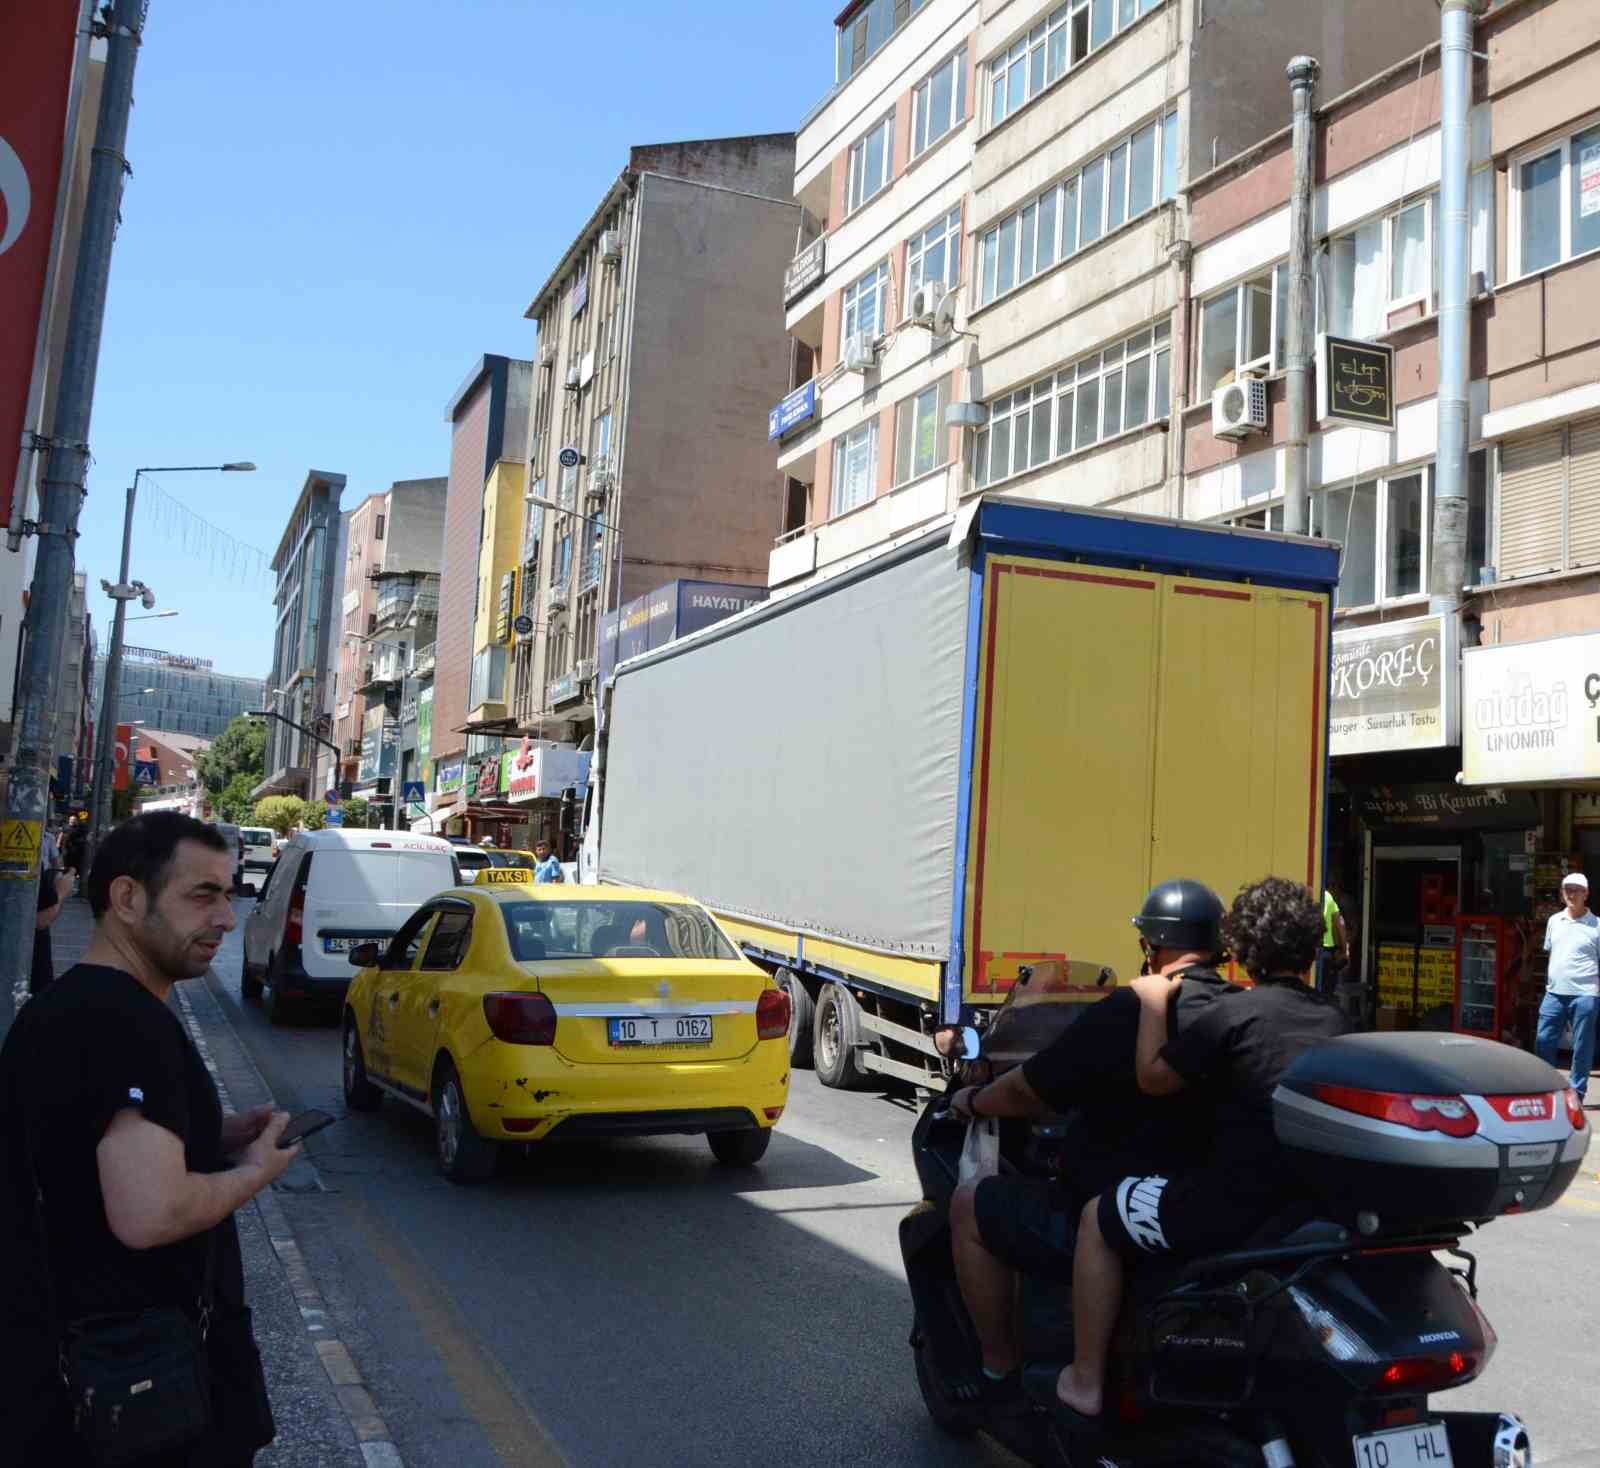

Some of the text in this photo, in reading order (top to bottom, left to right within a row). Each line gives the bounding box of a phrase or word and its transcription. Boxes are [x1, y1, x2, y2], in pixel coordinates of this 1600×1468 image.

[692, 595, 740, 611] HAYATI
[1410, 711, 1436, 727] Tostu
[621, 1019, 708, 1039] 10 T 0162
[1419, 1329, 1460, 1345] HONDA
[1363, 1431, 1446, 1468] 10 HL
